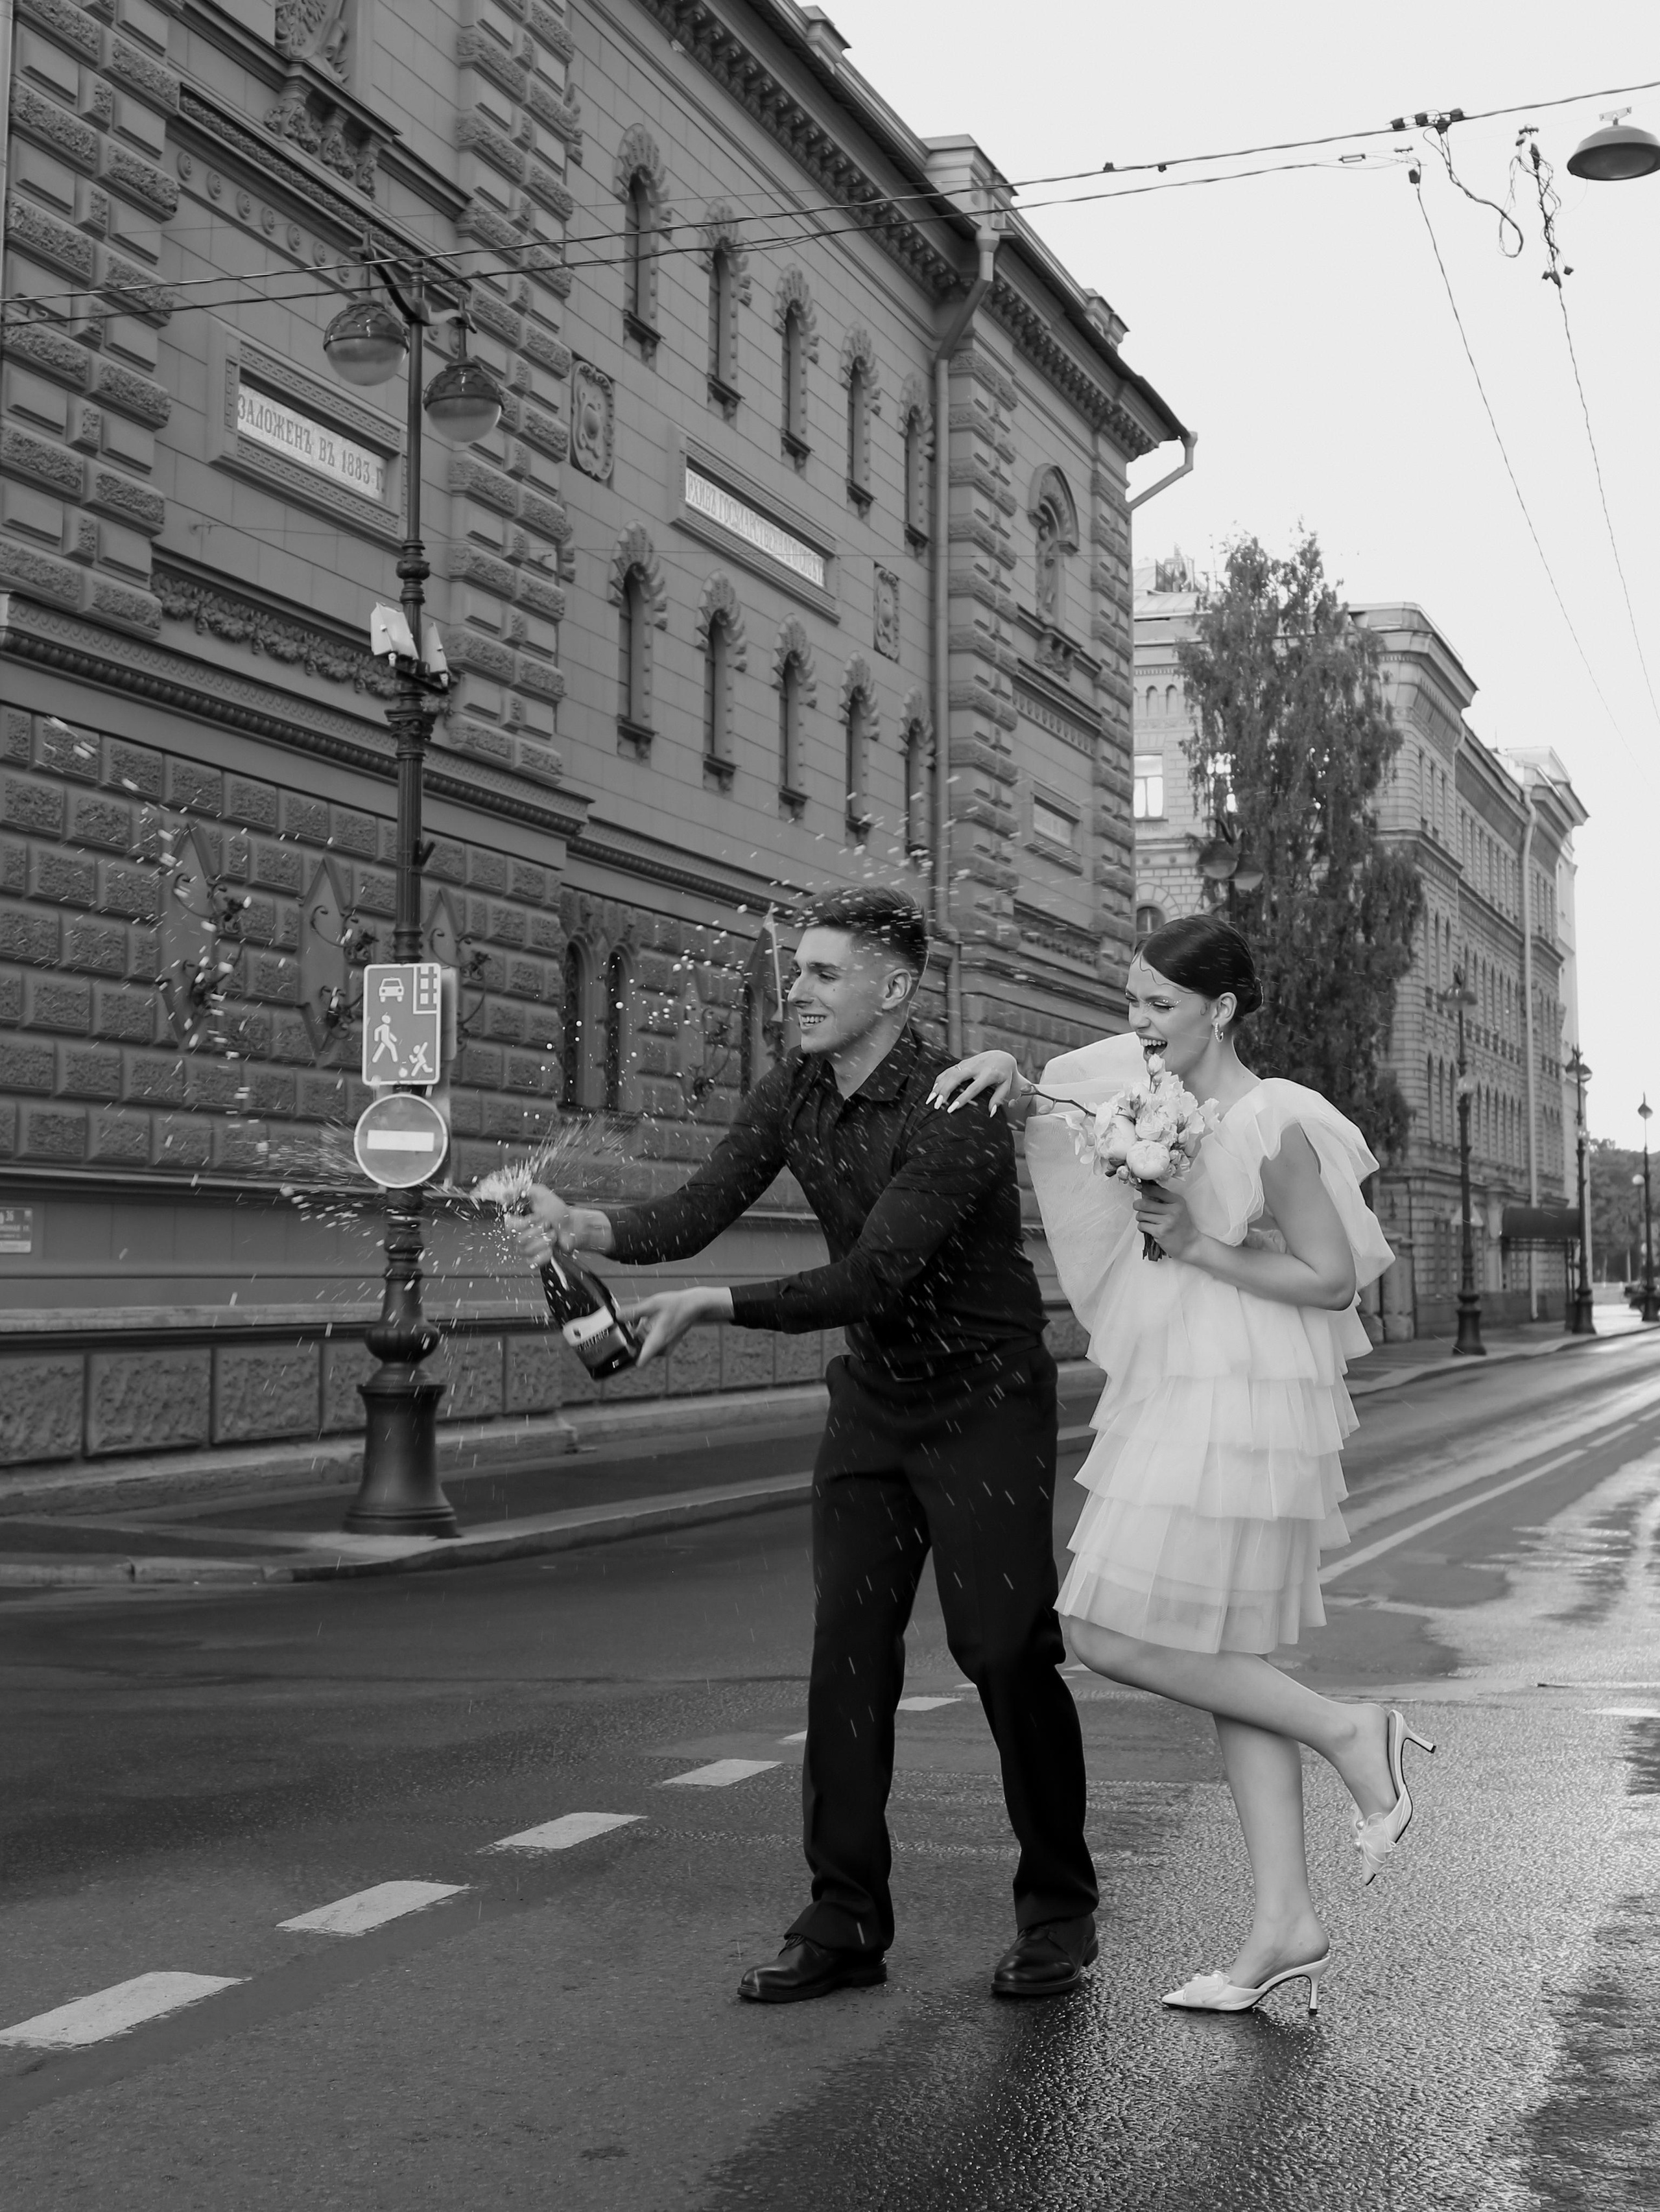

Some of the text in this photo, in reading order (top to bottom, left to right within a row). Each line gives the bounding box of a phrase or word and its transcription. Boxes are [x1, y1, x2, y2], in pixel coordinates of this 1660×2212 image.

[238, 394, 312, 455] ЗАЛОЖЕНЪ
[318, 436, 335, 467] ВЪ
[342, 449, 370, 485] 1883
[688, 472, 716, 516] РХИВЪ
